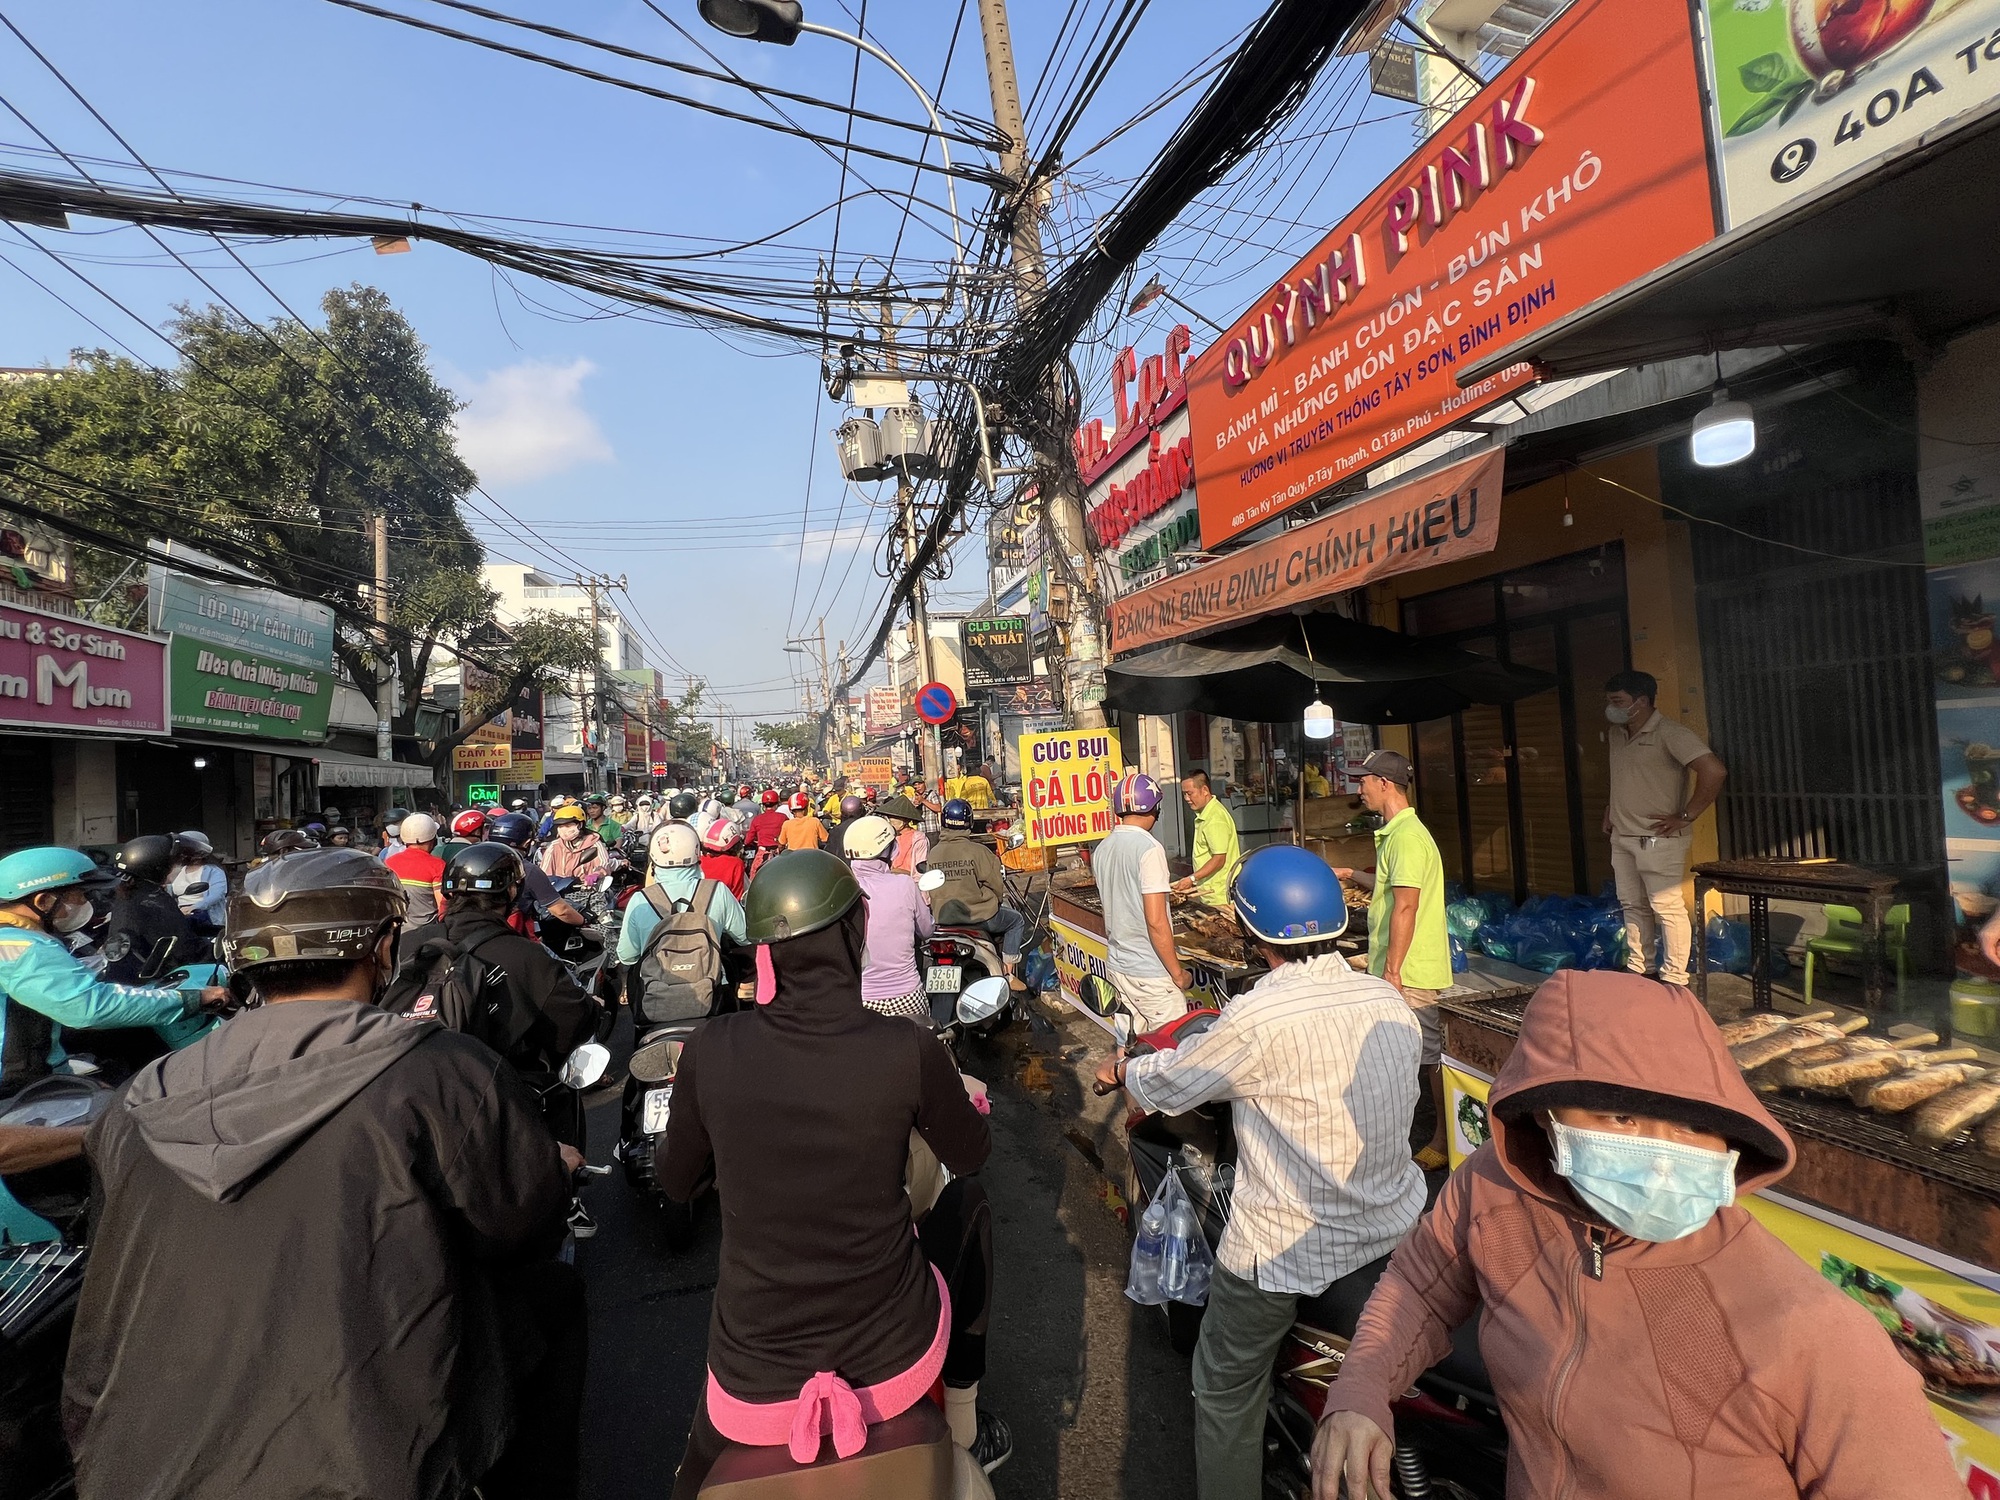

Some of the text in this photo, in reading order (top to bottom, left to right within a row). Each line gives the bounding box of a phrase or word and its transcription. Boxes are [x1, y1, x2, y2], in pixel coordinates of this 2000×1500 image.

[1833, 66, 1944, 147] 40A
[1223, 76, 1544, 386] QUỲNH PINK
[1216, 418, 1257, 450] BÁNH
[1261, 387, 1279, 419] MÌ
[1294, 340, 1349, 394] BÁNH
[1448, 220, 1511, 284] BÚN
[1521, 150, 1602, 232] KHÔ
[1247, 243, 1543, 456] VÀ NHỮNG MÓN ĐẶC SẢN
[1240, 455, 1274, 488] HƯƠNG
[1276, 447, 1288, 466] VỊ
[1289, 418, 1333, 458] TRUYỀN
[1336, 388, 1381, 429] THỐNG
[1384, 368, 1412, 399] TÂY
[1417, 343, 1457, 381] SƠN,
[1459, 313, 1502, 356] BÌNH
[1507, 279, 1556, 326] ĐỊNH
[1246, 506, 1260, 520] Tân
[1271, 490, 1287, 507] Tân
[1307, 465, 1334, 488] P.Tây
[1334, 447, 1370, 471] Thạnh,
[1371, 426, 1405, 452] Q.Tân
[1406, 410, 1432, 434] Phú
[1441, 377, 1497, 415] Hotline:
[1117, 603, 1154, 640] BÁNH
[1158, 589, 1177, 629] MÌ
[1180, 578, 1223, 621] BÌNH
[1226, 558, 1279, 609] ĐỊNH
[1285, 524, 1376, 586] CHÍNH
[1387, 488, 1478, 556] HIỆU
[198, 594, 228, 622] LỚP
[231, 606, 260, 634] DẠY
[264, 613, 291, 642] CẮM
[293, 627, 315, 649] HOA
[968, 621, 990, 632] CLB
[968, 633, 986, 648] ĐỆ
[989, 630, 1024, 645] NHẤT
[25, 622, 46, 645] &
[49, 627, 82, 651] Sơ
[82, 634, 126, 660] Sinh
[36, 654, 132, 709] Mum
[196, 650, 319, 695] Hoa Quả Nhập Khẩu
[204, 687, 238, 711] BÁNH
[261, 697, 281, 716] CÁC
[281, 703, 302, 724] LOẠI
[490, 748, 504, 757] XE
[862, 758, 890, 766] TRUNG
[1033, 737, 1109, 763] CÚC BỤI
[1029, 766, 1118, 809] CÁ LÓC
[1032, 812, 1087, 841] NƯỚNG
[17, 875, 51, 889] XANH
[671, 963, 696, 971] acer
[1067, 942, 1087, 972] CÚC
[928, 979, 958, 991] 338.94
